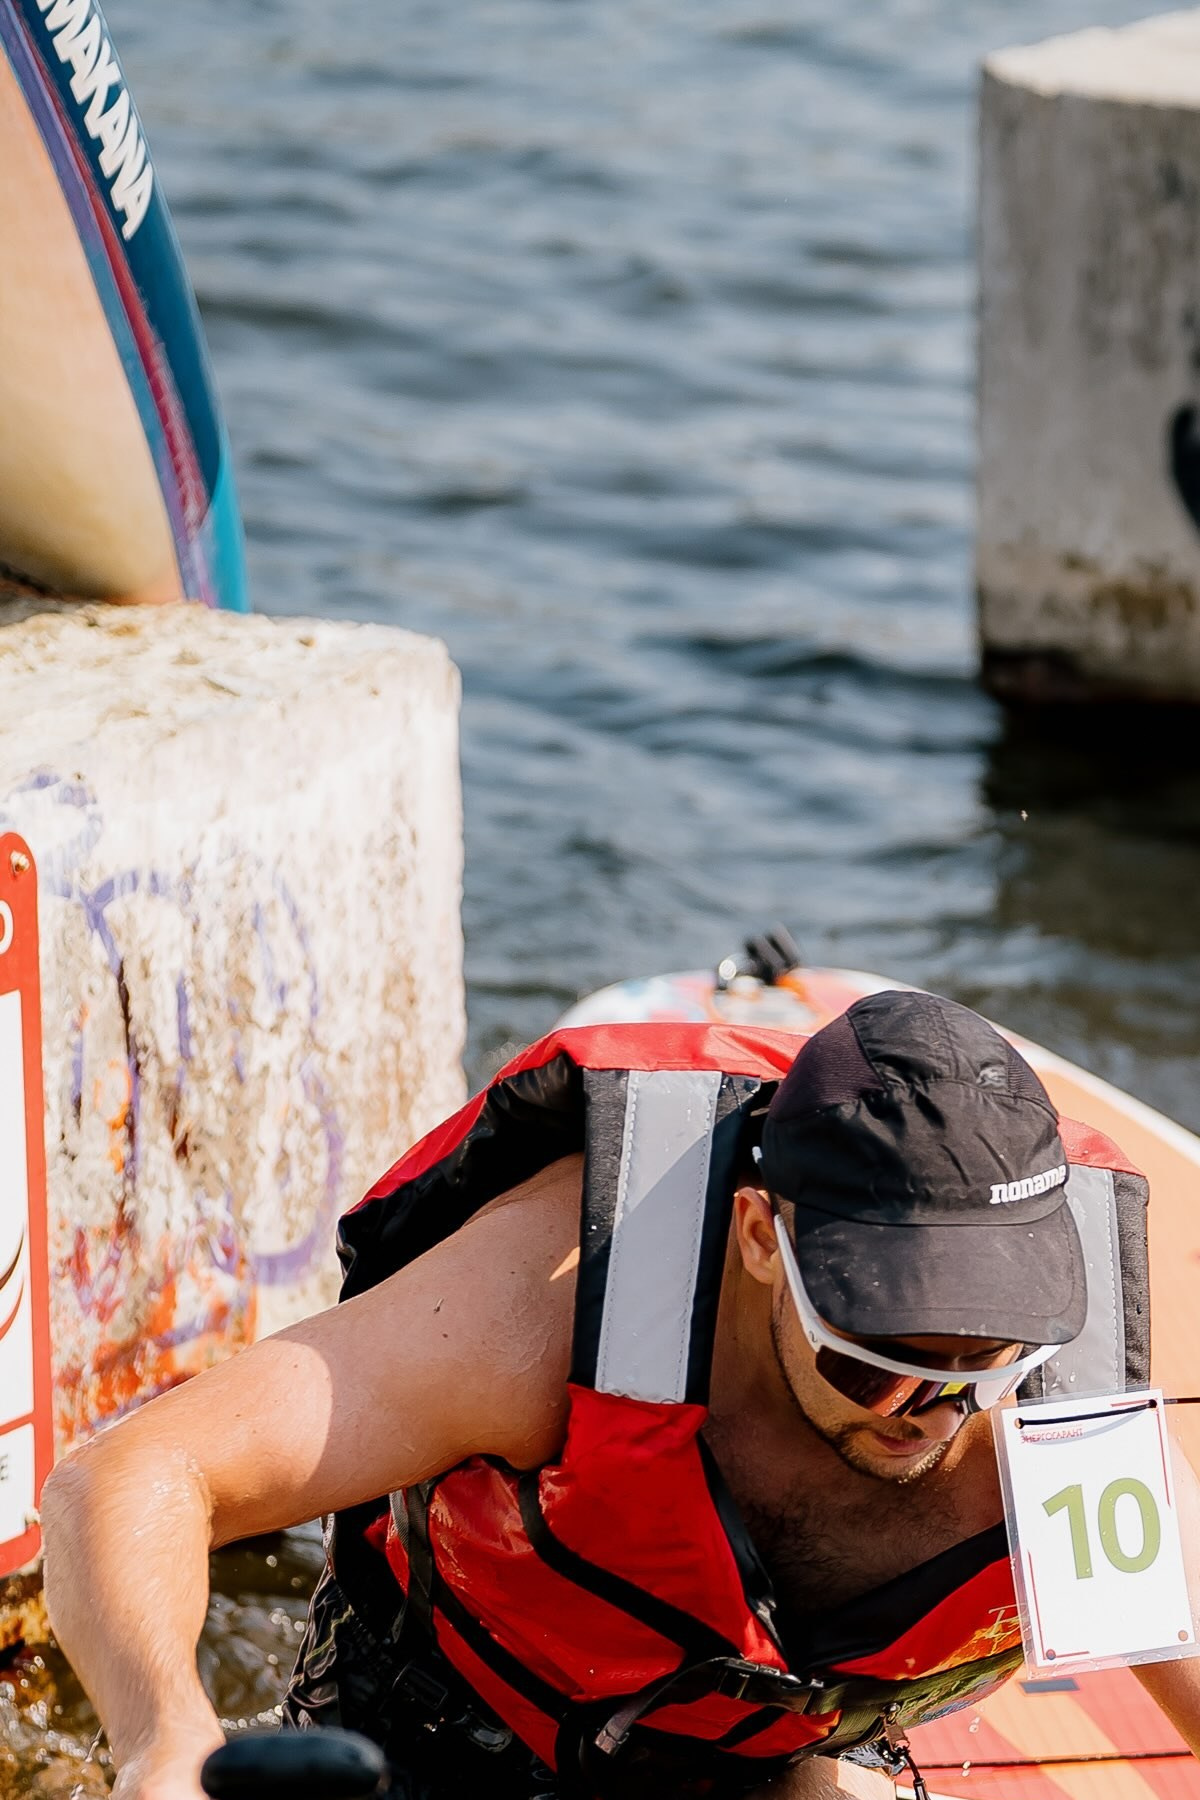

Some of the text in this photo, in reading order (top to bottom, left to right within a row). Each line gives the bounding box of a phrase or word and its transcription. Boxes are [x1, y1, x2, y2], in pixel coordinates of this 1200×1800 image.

[989, 1165, 1067, 1204] noname
[1020, 1428, 1083, 1443] ЭНЕРГОГАРАНТ
[1042, 1477, 1161, 1580] 10
